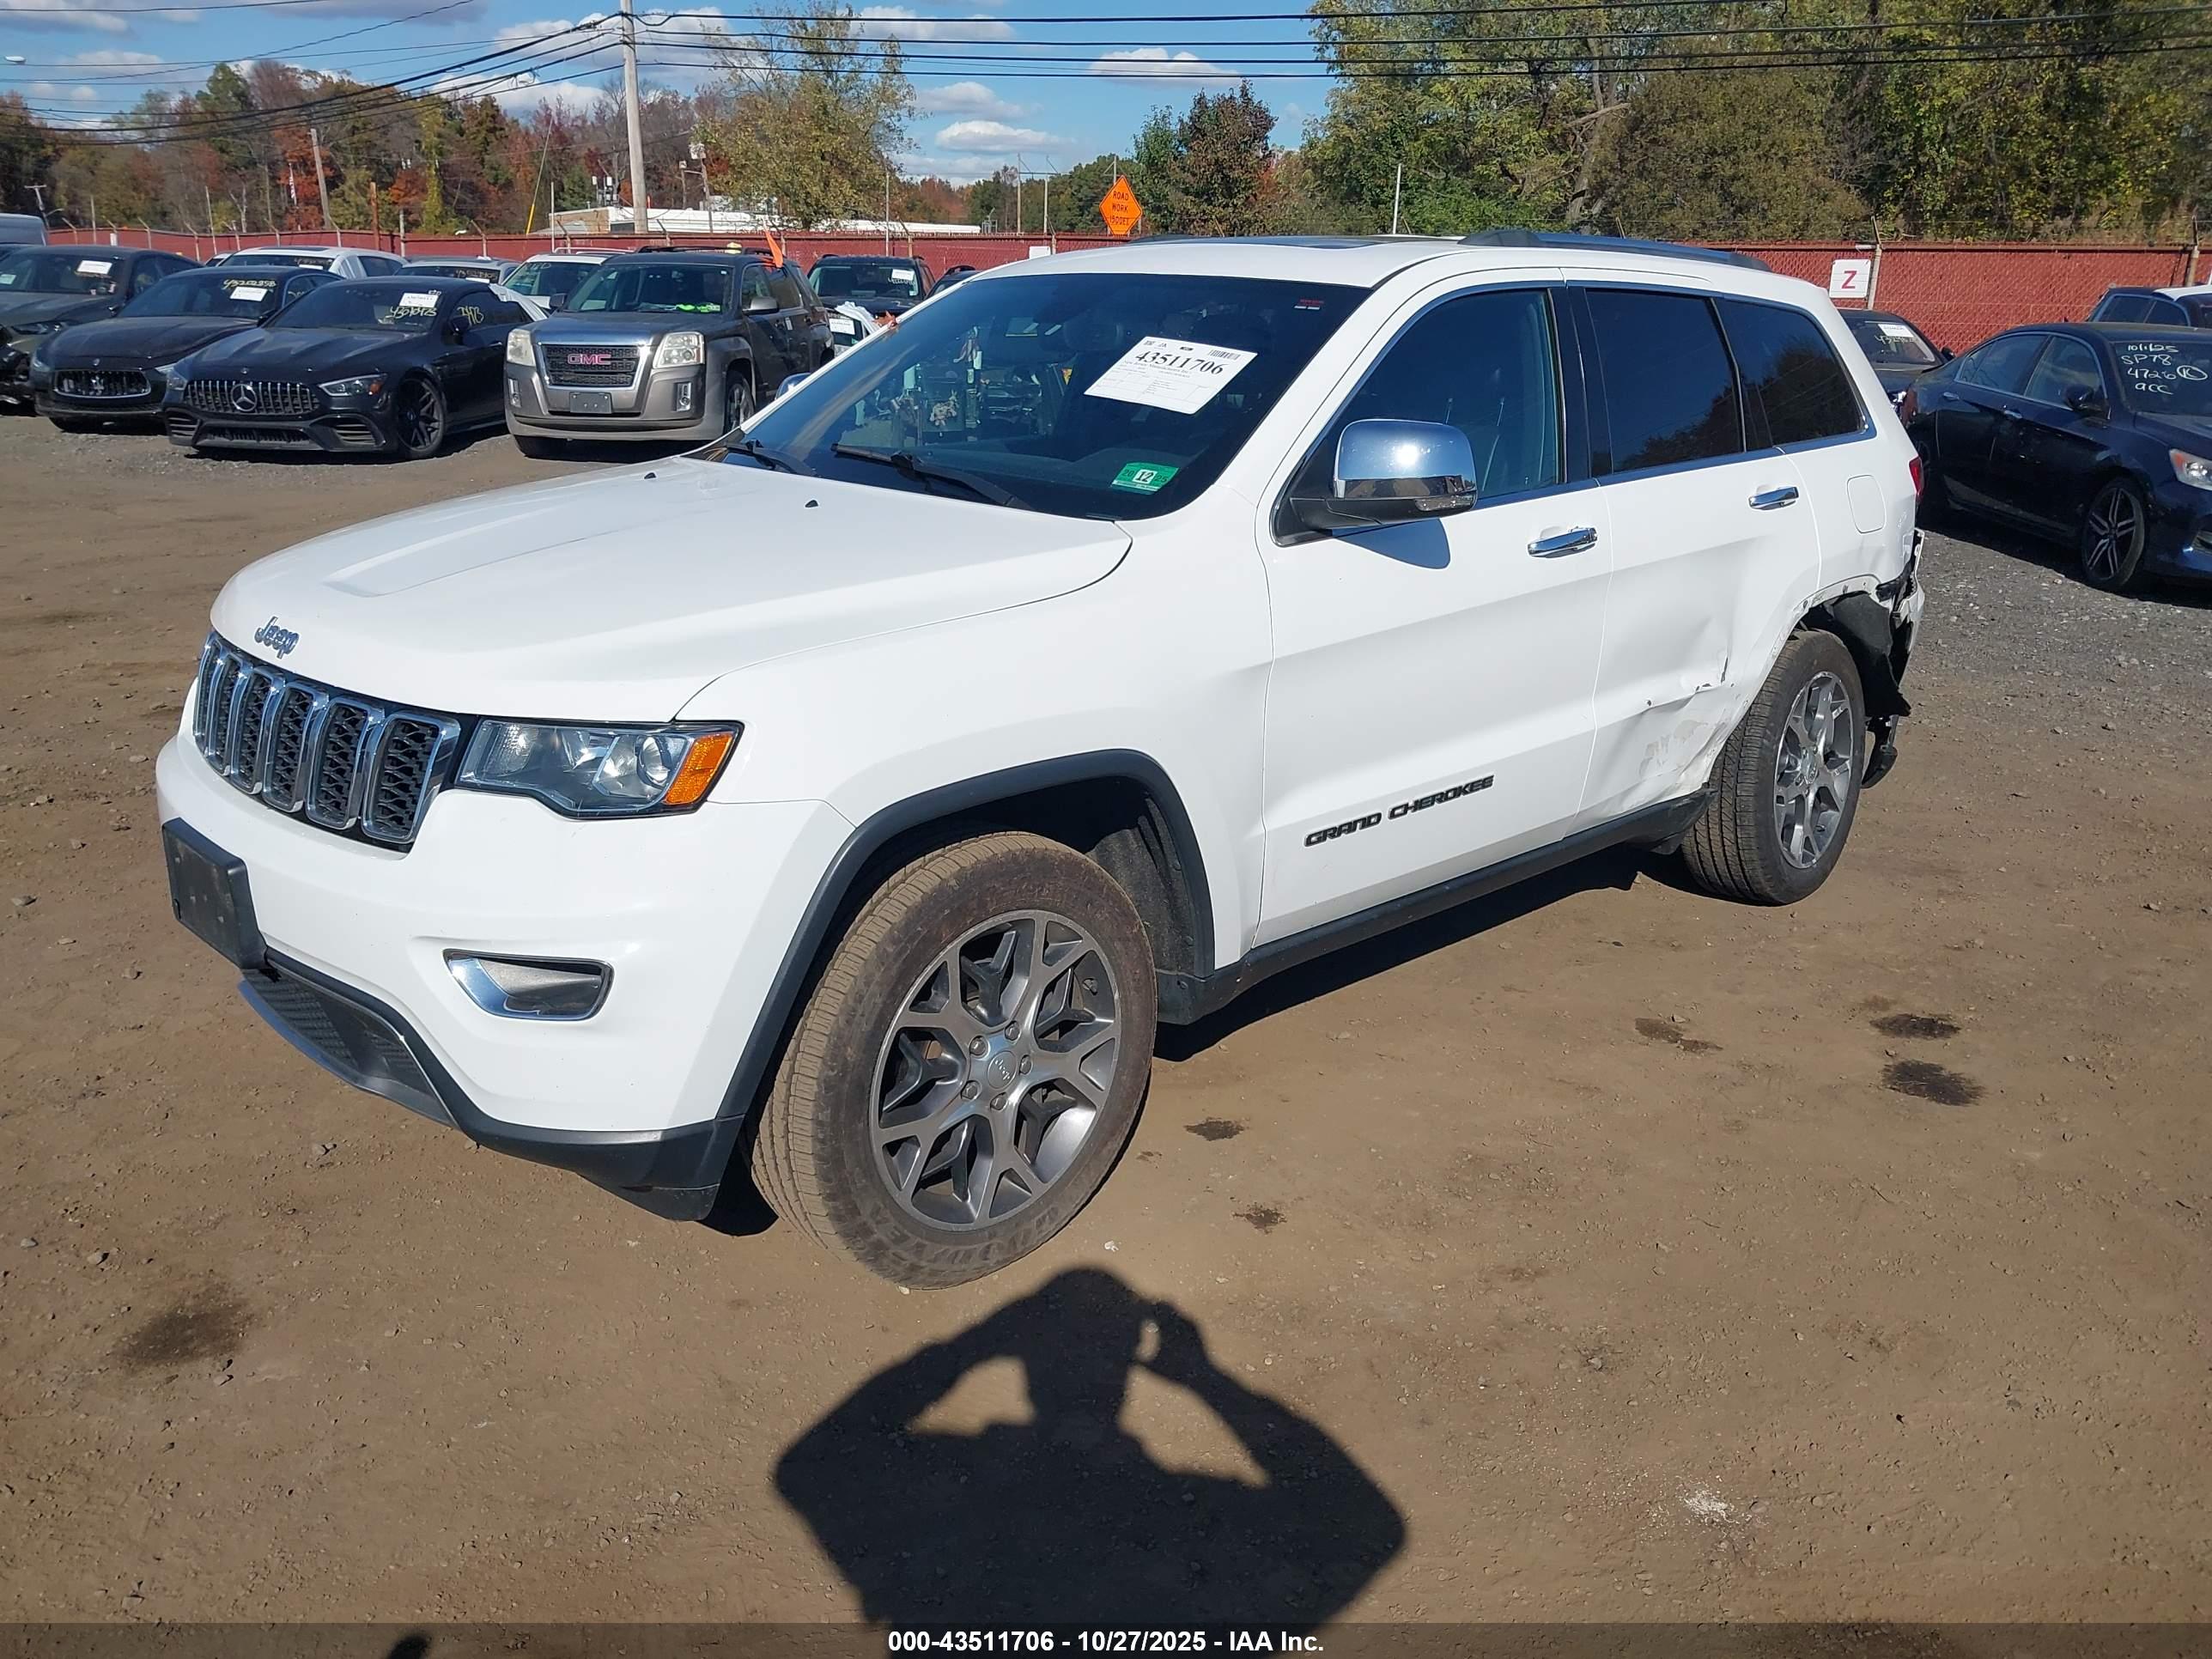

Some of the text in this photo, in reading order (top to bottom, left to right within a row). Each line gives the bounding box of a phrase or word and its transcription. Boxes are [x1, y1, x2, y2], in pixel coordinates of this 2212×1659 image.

[1113, 191, 1128, 201] ROAD
[1112, 203, 1128, 213] WORK
[1841, 270, 1857, 289] Z
[568, 353, 611, 365] GMC
[1135, 350, 1230, 375] 43511706
[2121, 354, 2171, 366] SP78
[2127, 368, 2177, 380] 4726
[1134, 471, 1154, 482] 12
[254, 616, 300, 659] Jeep
[1304, 775, 1494, 847] GRAND CHEROKEE
